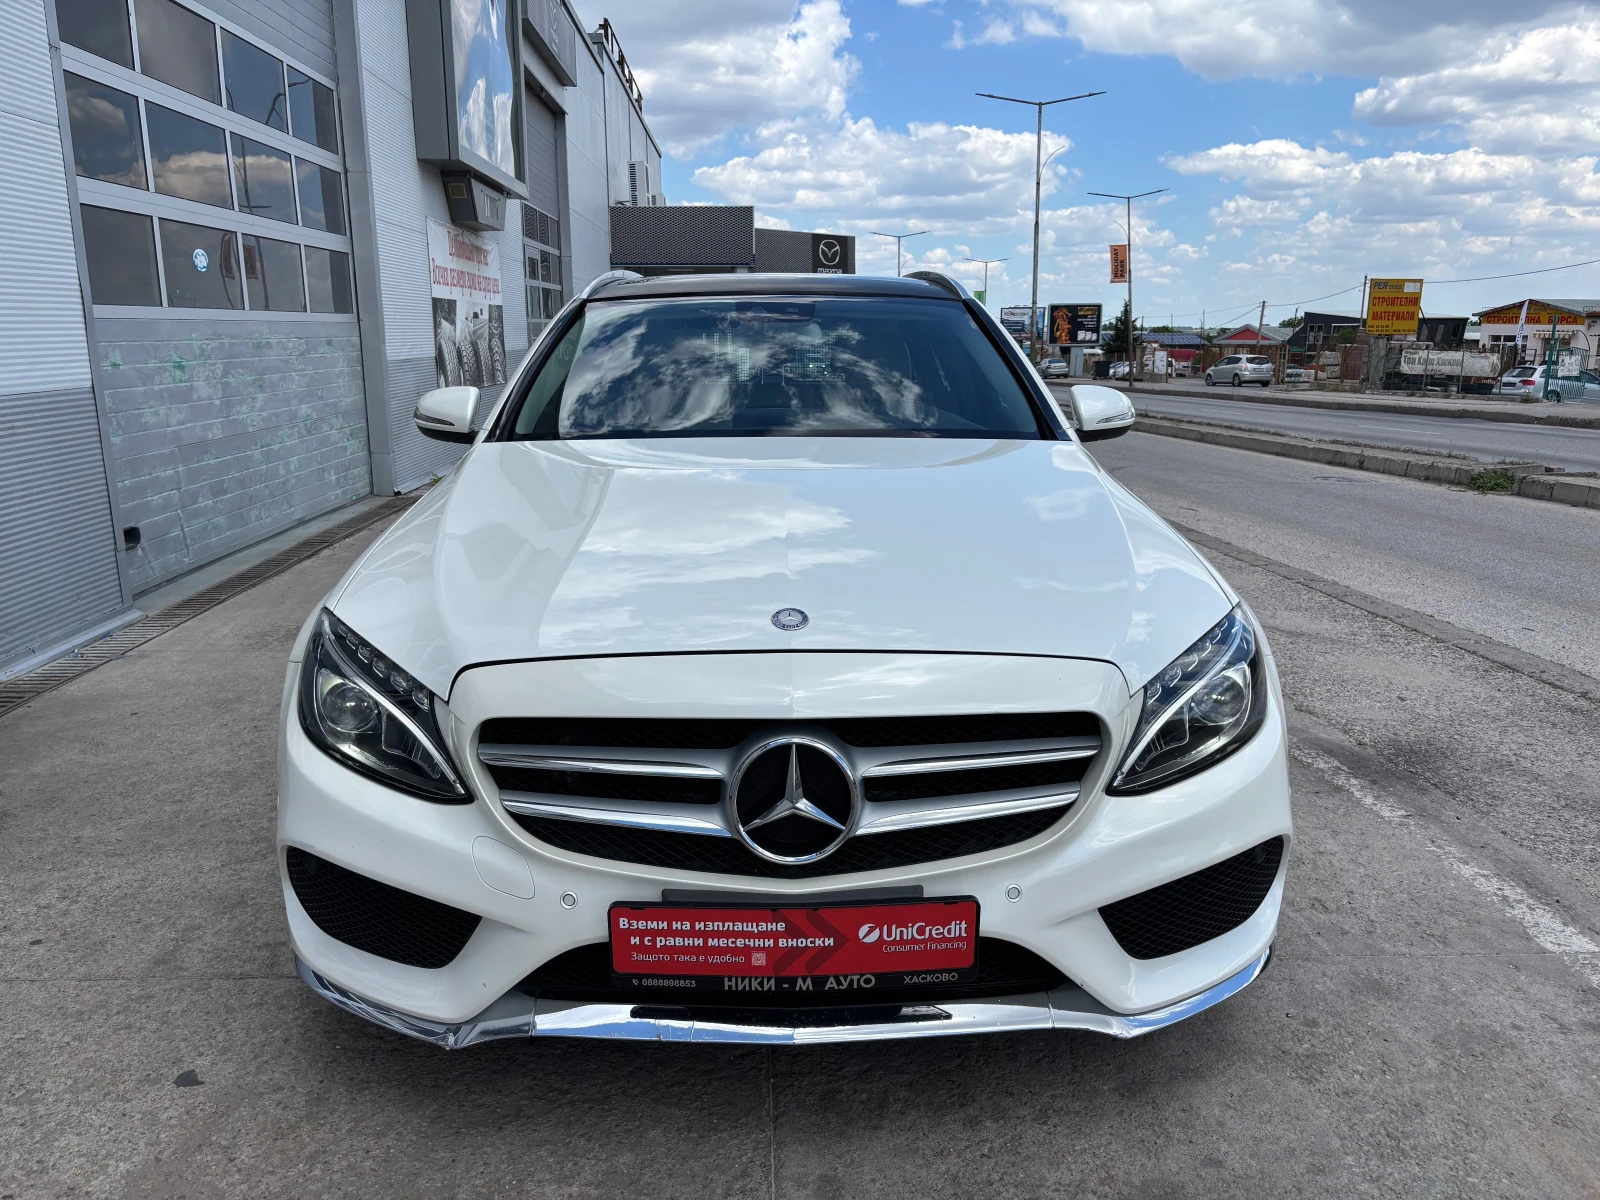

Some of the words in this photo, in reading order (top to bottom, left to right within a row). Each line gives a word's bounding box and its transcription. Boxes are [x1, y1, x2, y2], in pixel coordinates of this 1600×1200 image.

[1372, 297, 1418, 306] СТРОИТЕЛНИ
[1372, 311, 1415, 321] МАТЕРИАЛИ
[1486, 316, 1541, 324] СТРОИТЛНА
[1548, 316, 1578, 324] БРСА
[619, 917, 668, 930] Вземи
[672, 920, 690, 930] на
[695, 920, 786, 933] изплащане
[883, 920, 967, 941] UniCredit
[630, 935, 640, 945] и
[644, 936, 652, 945] с
[657, 936, 703, 948] равни
[708, 937, 774, 947] месечни
[779, 937, 834, 947] вноски
[883, 943, 925, 952] Consumer
[927, 941, 967, 951] Financing
[631, 952, 671, 962] Защото
[673, 954, 696, 962] така
[708, 953, 745, 964] удобно
[642, 979, 696, 988] 0888898853
[724, 976, 776, 991] НИКИ
[795, 977, 813, 991] М
[825, 975, 876, 990] АУТО
[904, 973, 958, 984] ХАСКОВО
